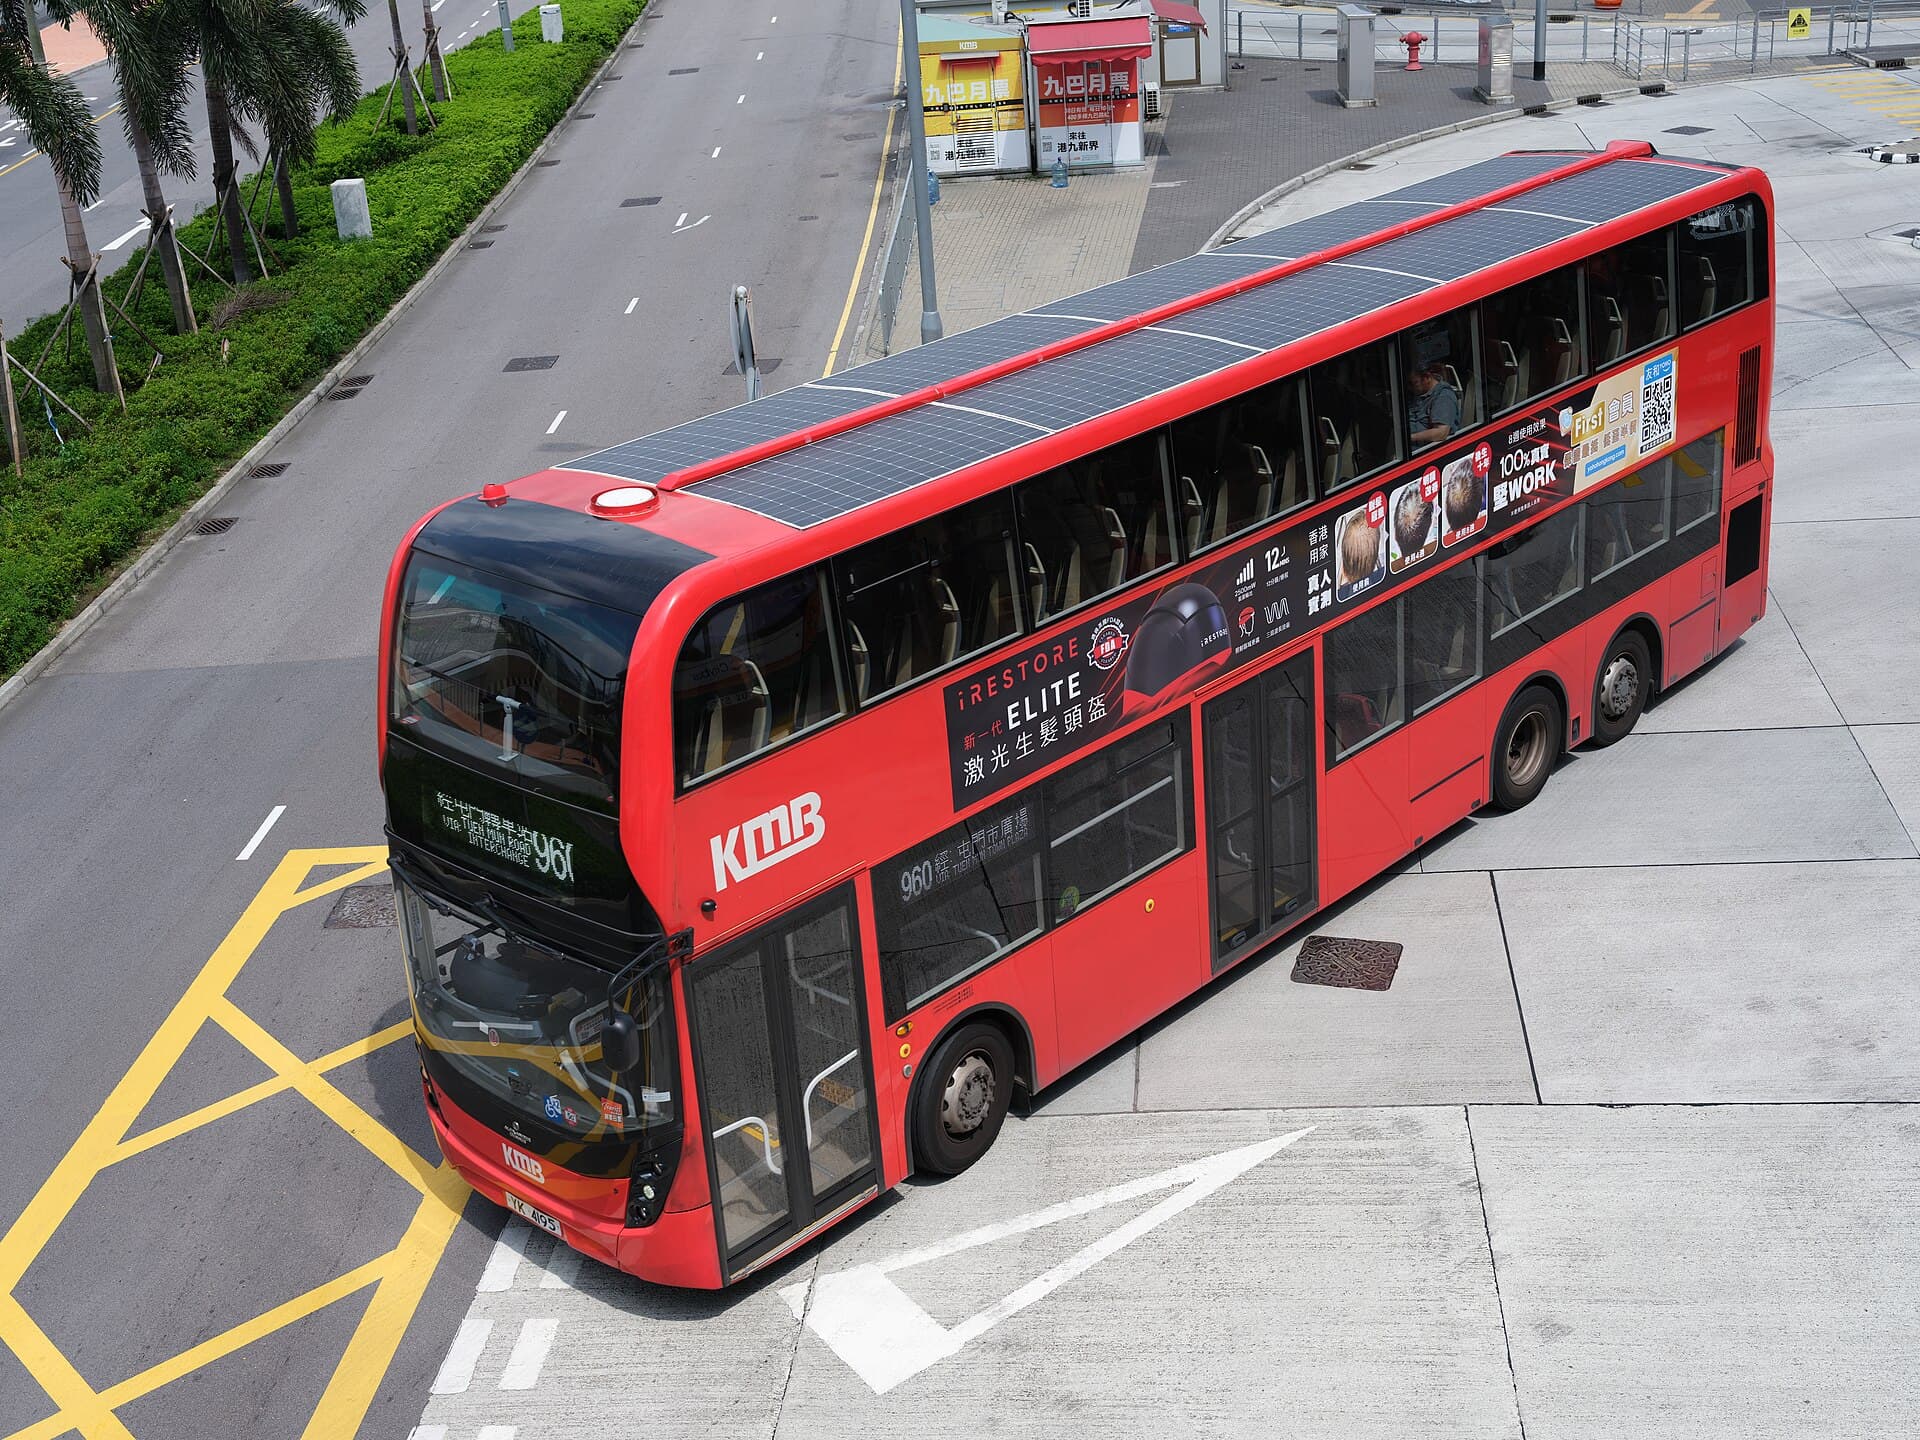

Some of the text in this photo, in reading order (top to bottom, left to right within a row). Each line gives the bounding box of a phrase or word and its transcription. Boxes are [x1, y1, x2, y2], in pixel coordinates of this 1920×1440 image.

[959, 42, 978, 50] KMB
[926, 79, 1010, 104] 九巴月票
[1044, 72, 1129, 96] 九巴月票
[1057, 140, 1099, 153] 港九新界
[1069, 132, 1087, 140] 來往
[1645, 364, 1660, 381] 友和
[1575, 407, 1603, 438] First
[1608, 390, 1635, 423] 會員
[1309, 525, 1329, 547] 香港
[1265, 546, 1281, 572] 12
[1309, 543, 1329, 565] 用家
[1307, 568, 1332, 595] 真人
[1100, 639, 1116, 655] FDA
[958, 638, 1079, 711] iRESTORE
[1007, 671, 1082, 731] ELITE
[963, 720, 1004, 751] 新一代
[963, 692, 1108, 787] 激光生髮頭盔
[710, 791, 826, 893] KMB
[957, 807, 1028, 859] 屯門市廣場
[468, 832, 530, 868] INTERCHANGE
[901, 860, 933, 902] 960
[502, 1142, 545, 1184] KMB
[510, 1196, 557, 1231] YK 4195
